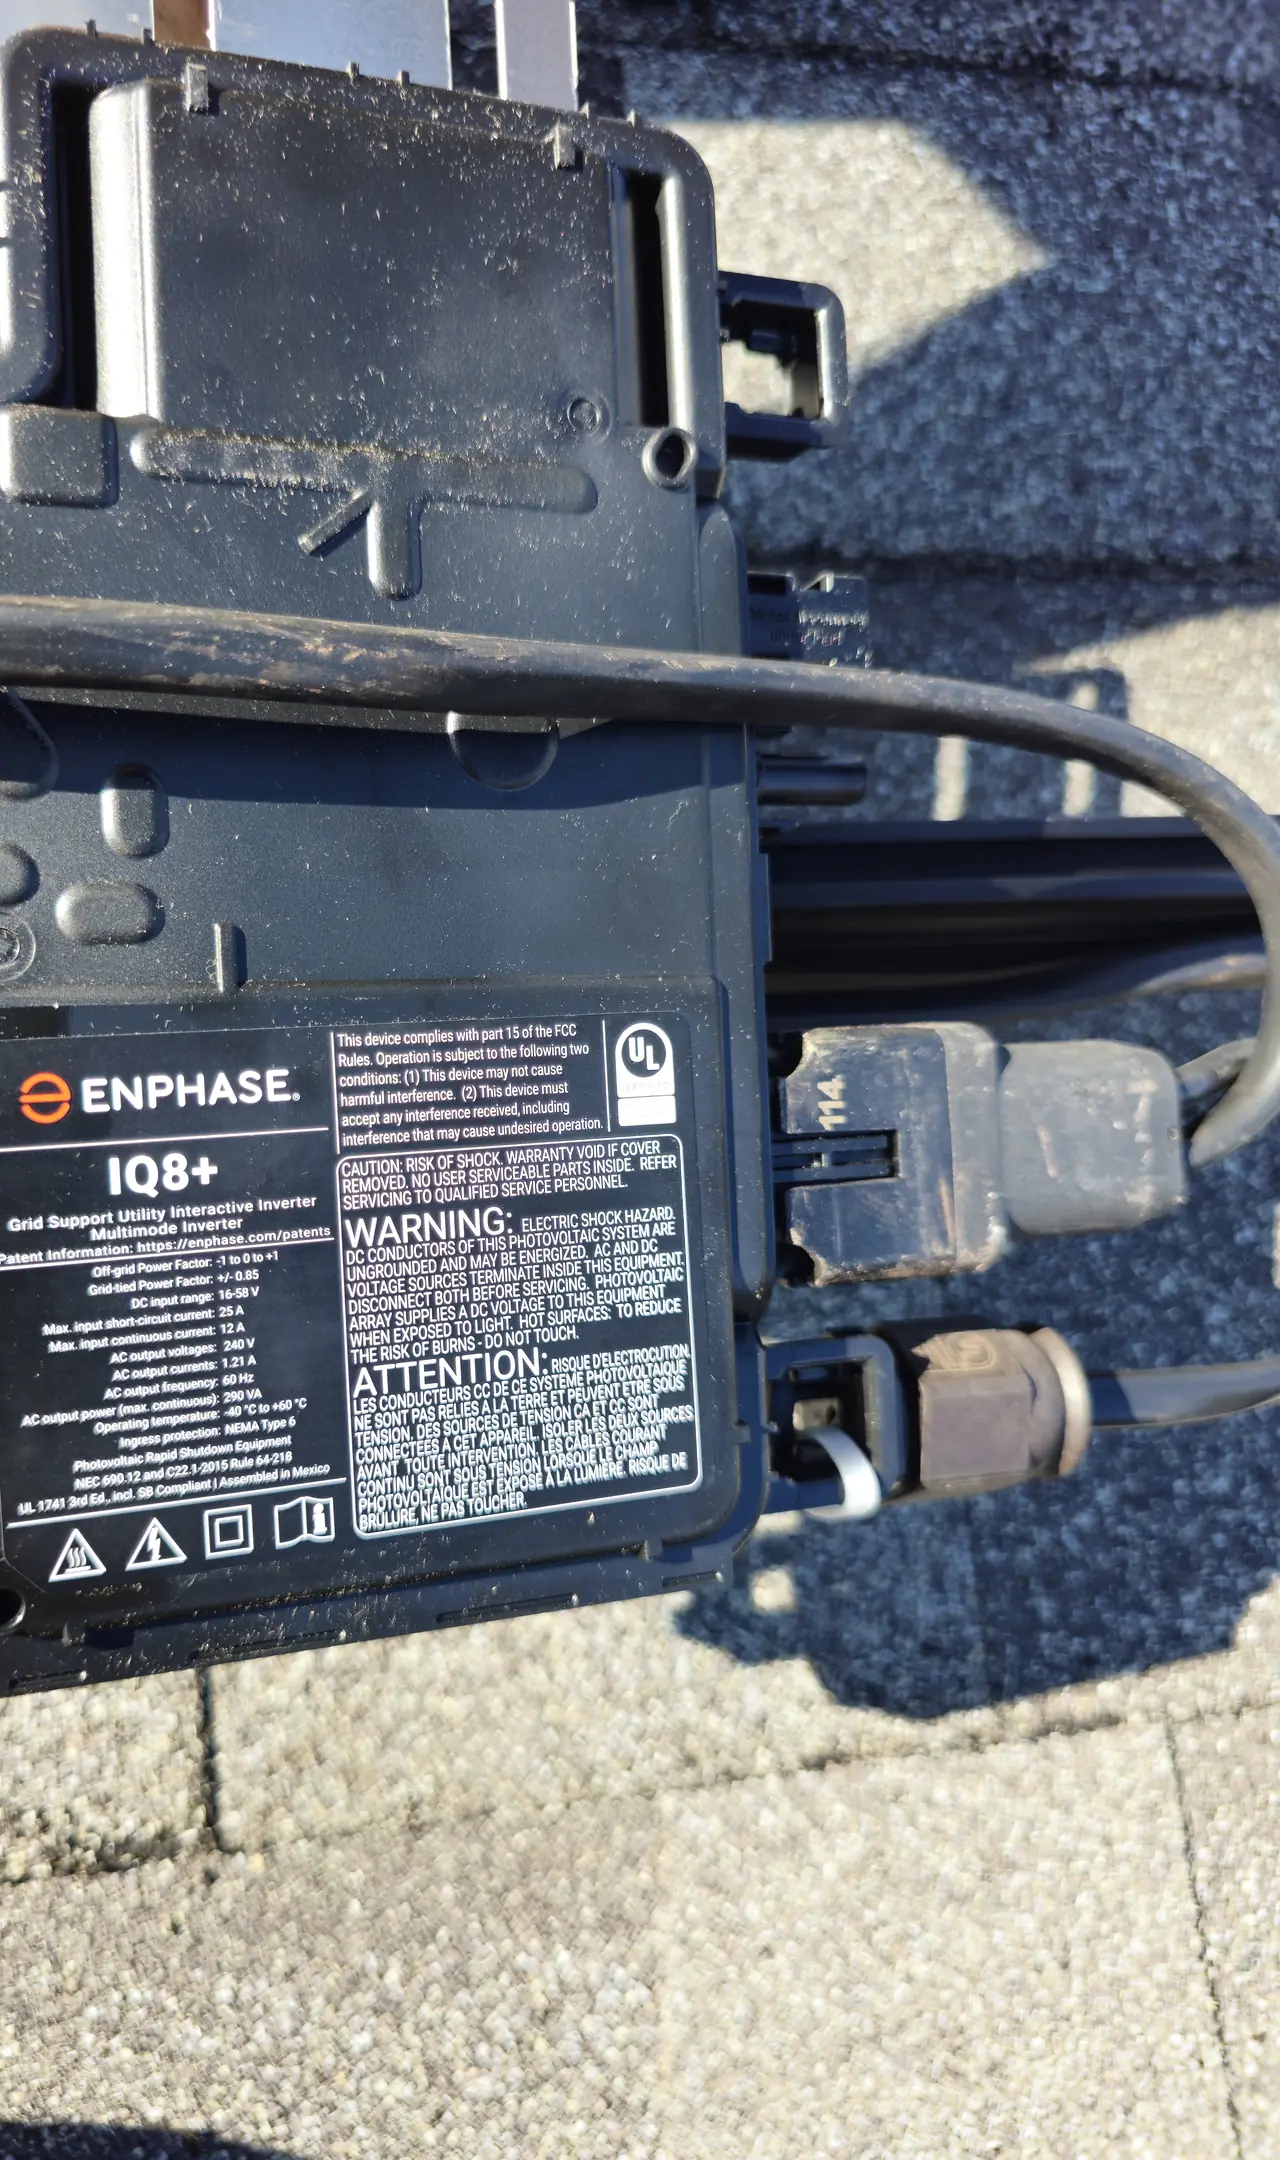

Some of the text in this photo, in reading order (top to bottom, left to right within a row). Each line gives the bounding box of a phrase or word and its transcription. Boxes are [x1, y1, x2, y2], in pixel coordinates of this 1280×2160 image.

[337, 1023, 577, 1047] This device complies with part 15 of the FCC
[337, 1043, 590, 1068] Rules. Operation is subject to the following two
[628, 1036, 660, 1071] UL
[338, 1064, 563, 1087] conditions: (1) This device may not cause
[339, 1081, 569, 1107] harmful interference. (2) This device must
[817, 1077, 847, 1131] 114
[341, 1100, 570, 1128] accept any interference received, including
[341, 1117, 603, 1147] interference that may cause undesired operation.
[341, 1141, 661, 1177] CAUTION: RISK OF SHOCK. WARRANTY VOID IF COVER
[108, 1151, 218, 1198] IQ8+
[341, 1155, 677, 1194] REMOVED. NO USER SERVICEABLE PARTS INSIDE. REFER
[342, 1175, 628, 1210] SERVICING TO QUALIFIED SERVICE PERSONNEL.
[6, 1196, 317, 1232] Grid Support Utility Interactive Inverter
[89, 1217, 243, 1241] Multimode Inverter
[344, 1206, 513, 1247] WARNING:
[521, 1207, 676, 1232] ELECTRIC SHOCK HAZARD.
[0, 1250, 44, 1265] Patent
[45, 1244, 134, 1261] Information:
[345, 1222, 676, 1265] DC CONDUCTORS OF THIS PHOTOVOLTAIC SYSTEM ARE
[91, 1262, 136, 1279] Off-grid
[136, 1261, 174, 1274] Power
[173, 1257, 213, 1270] Factor:
[228, 1254, 241, 1265] to
[241, 1252, 251, 1264] 0
[251, 1252, 264, 1263] to
[264, 1250, 278, 1261] +1
[346, 1238, 658, 1281] UNGROUNDED AND MAY BE ENERGIZED. AC AND DC
[87, 1279, 137, 1296] Grid-tied
[137, 1278, 174, 1291] Power
[174, 1275, 214, 1287] Factor:
[234, 1268, 260, 1282] 0.85
[130, 1285, 260, 1310] DC input range: 16-58 V
[41, 1304, 245, 1336] Max. input short-circuit current: 25 A
[47, 1321, 246, 1353] Max. input continuous current: 12 A
[109, 1337, 255, 1364] AC output voltages: 240 V
[111, 1354, 257, 1382] AC output currents: 1.21 A
[354, 1348, 548, 1394] ATTENTION:
[550, 1354, 591, 1371] RISQUE
[352, 1398, 377, 1414] LES
[378, 1386, 472, 1410] CONDUCTEURS
[472, 1384, 491, 1399] CC
[492, 1382, 510, 1397] DE
[511, 1380, 528, 1395] CE
[585, 1361, 687, 1386] PHOTOVOLTAIQUE
